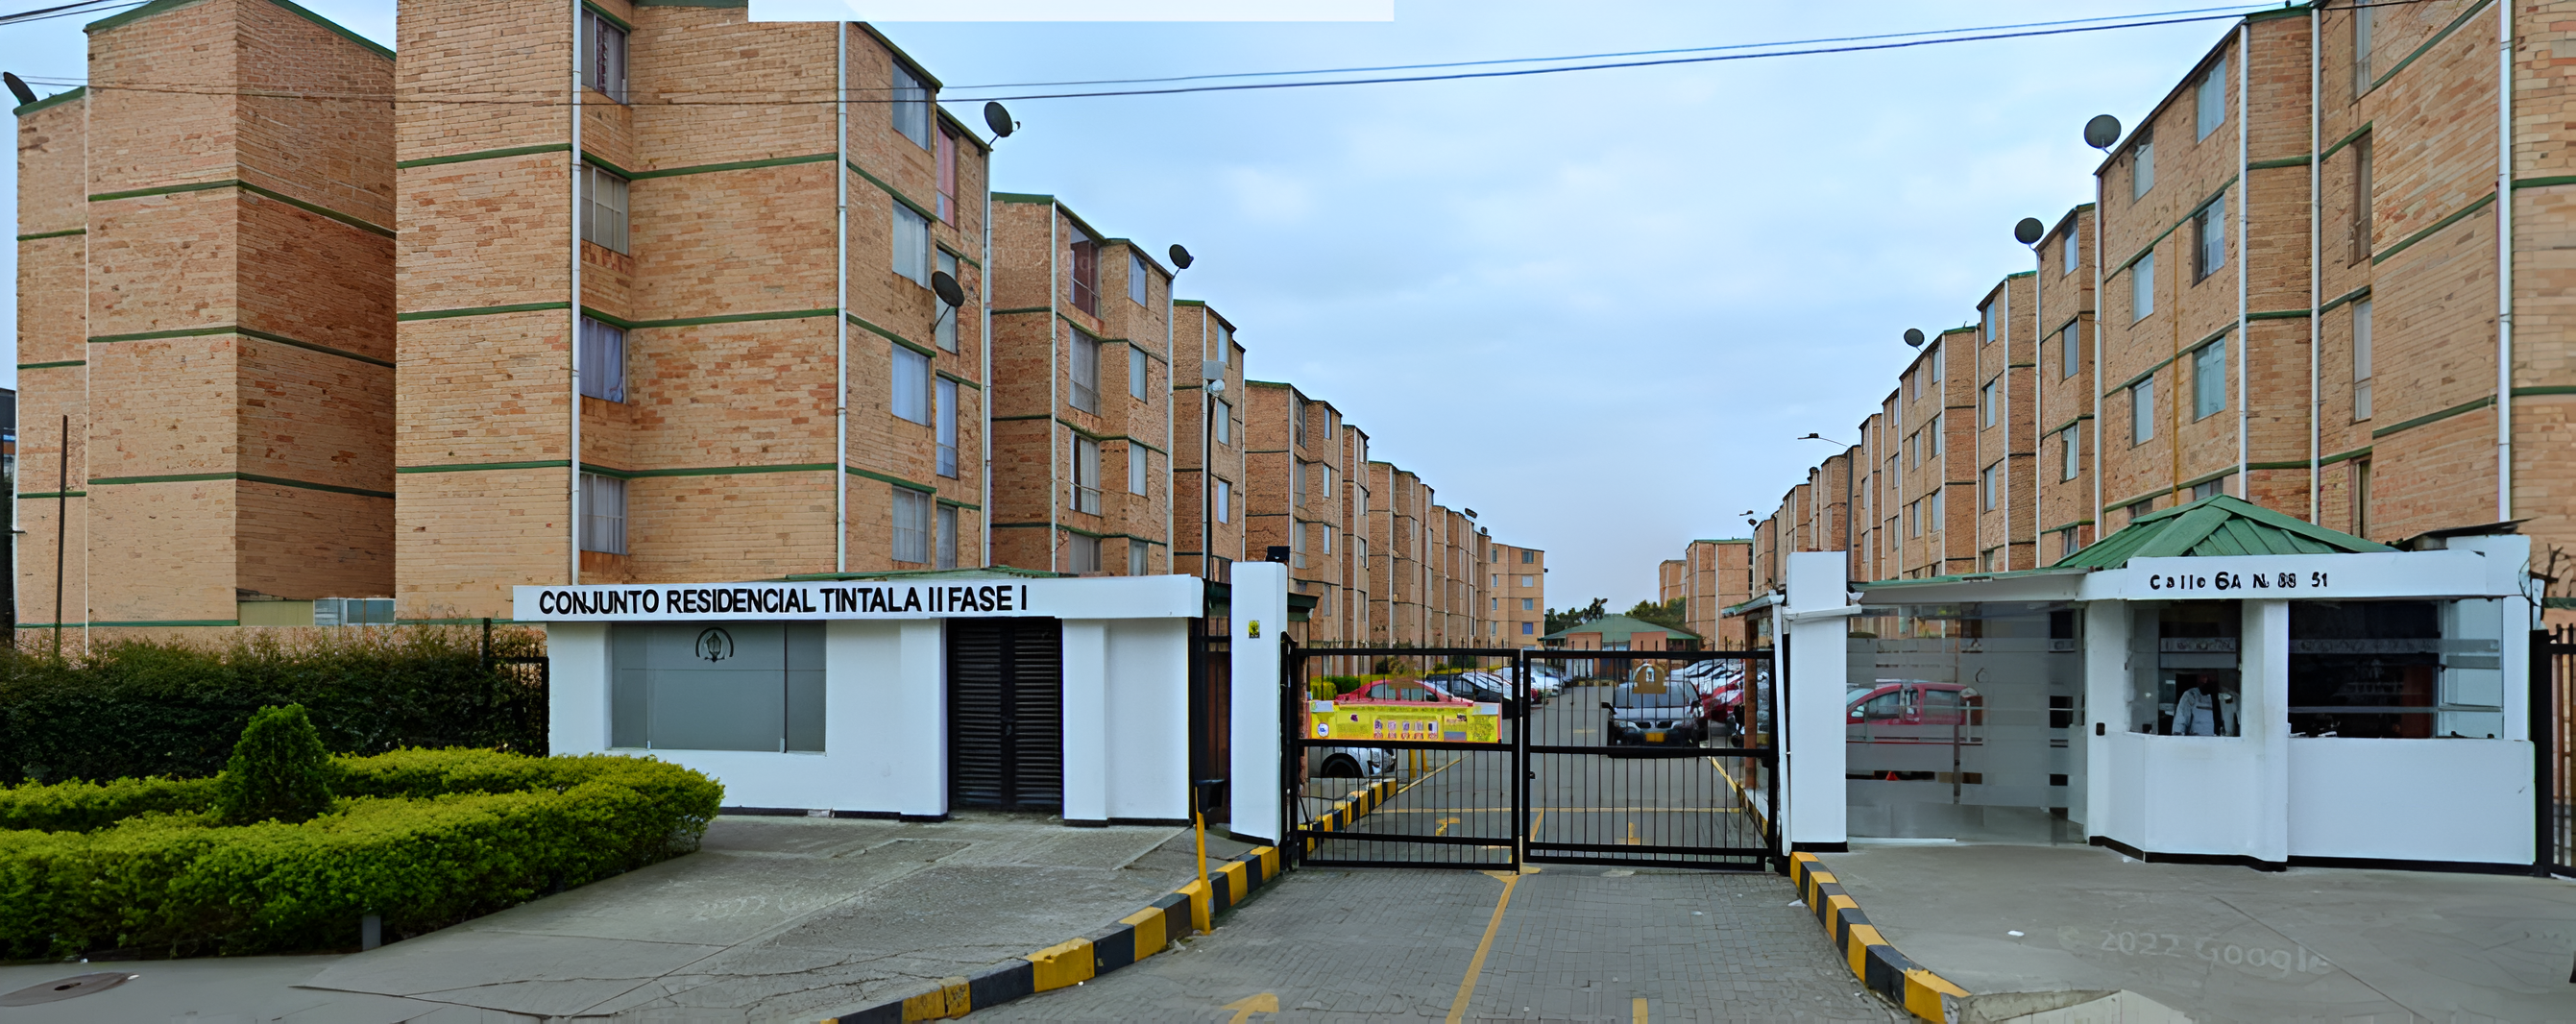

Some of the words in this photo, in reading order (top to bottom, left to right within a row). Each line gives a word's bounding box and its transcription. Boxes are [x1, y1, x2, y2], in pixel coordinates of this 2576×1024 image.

[2214, 571, 2242, 590] 6A
[2311, 572, 2328, 588] 51
[540, 590, 660, 615] CONJUNTO
[668, 589, 816, 613] RESIDENCIAL
[819, 587, 922, 613] TINTALA
[928, 587, 943, 612] II
[948, 585, 1013, 612] FASE
[1021, 585, 1027, 610] I
